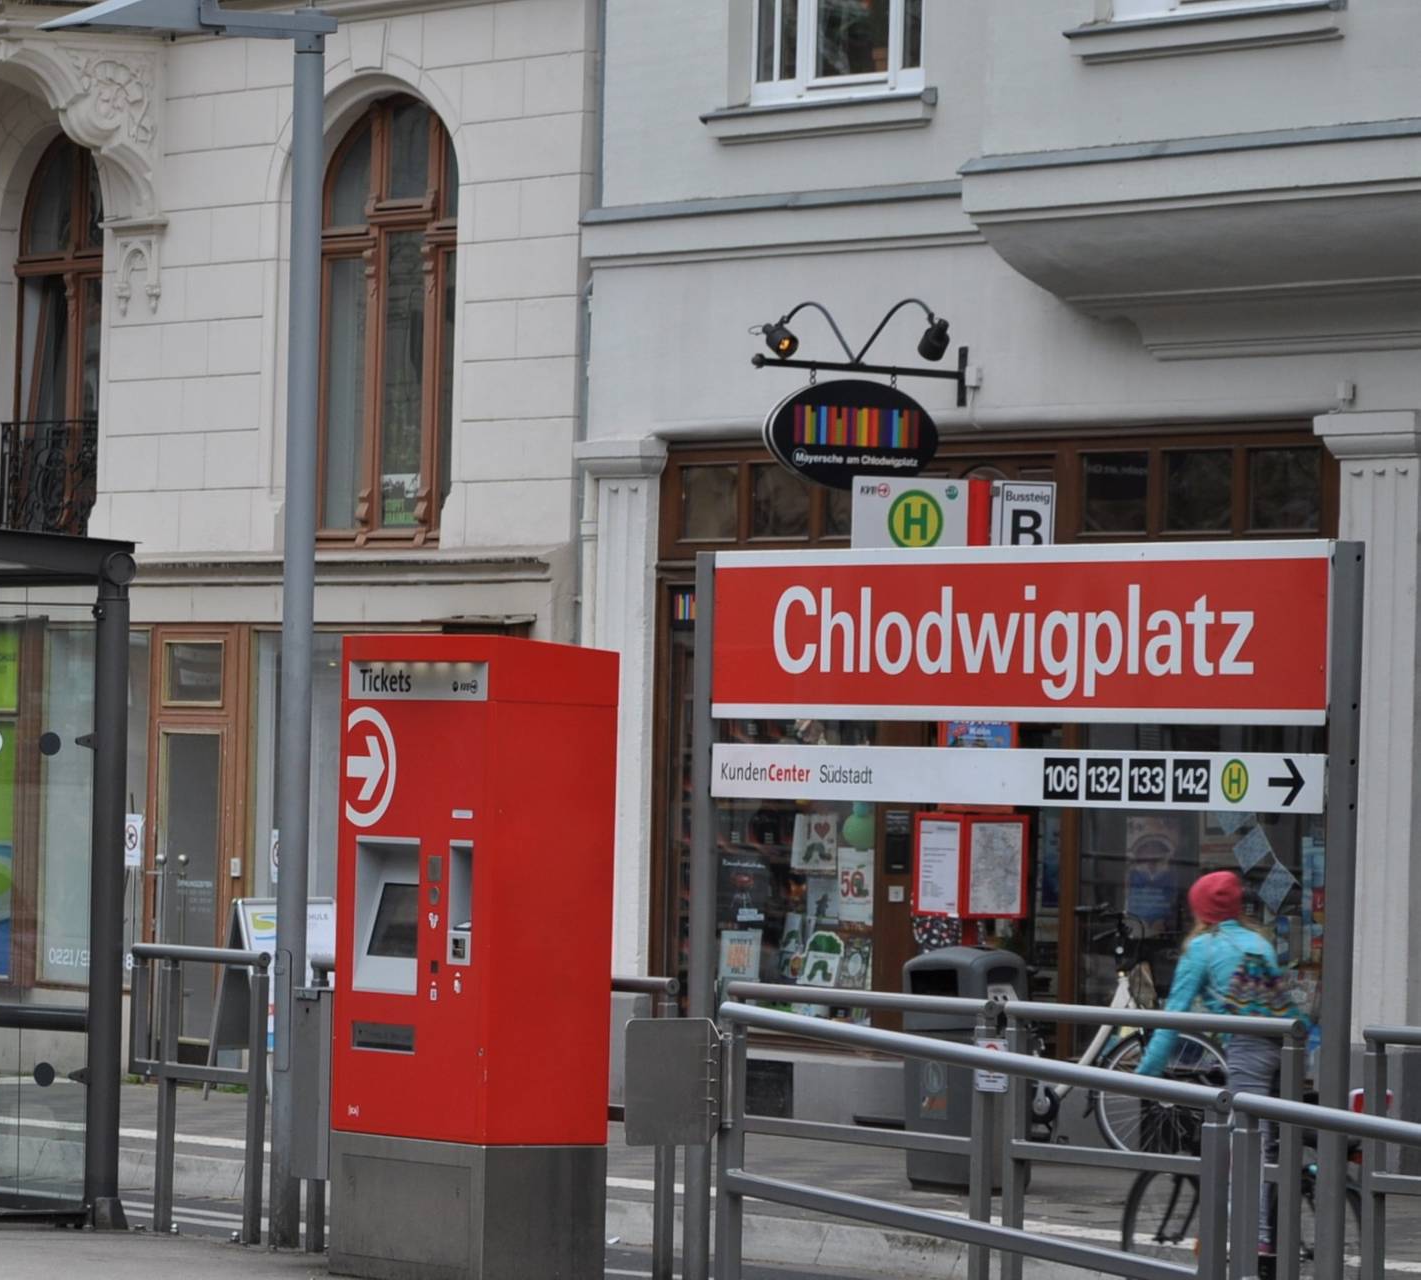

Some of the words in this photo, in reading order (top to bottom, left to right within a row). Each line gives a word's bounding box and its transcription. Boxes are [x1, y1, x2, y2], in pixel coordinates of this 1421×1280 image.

[795, 452, 843, 464] Mayersche
[861, 455, 918, 468] Chlodwigplatz
[1006, 490, 1050, 504] Bussteig
[1011, 509, 1043, 545] B
[773, 584, 1254, 700] Chlodwigplatz
[360, 668, 411, 692] Tickets
[721, 762, 810, 782] KundenCenter
[819, 764, 873, 784] Südstadt
[1045, 765, 1077, 792] 106
[1088, 766, 1120, 793] 132
[1131, 766, 1164, 794] 133
[1175, 768, 1208, 795] 142
